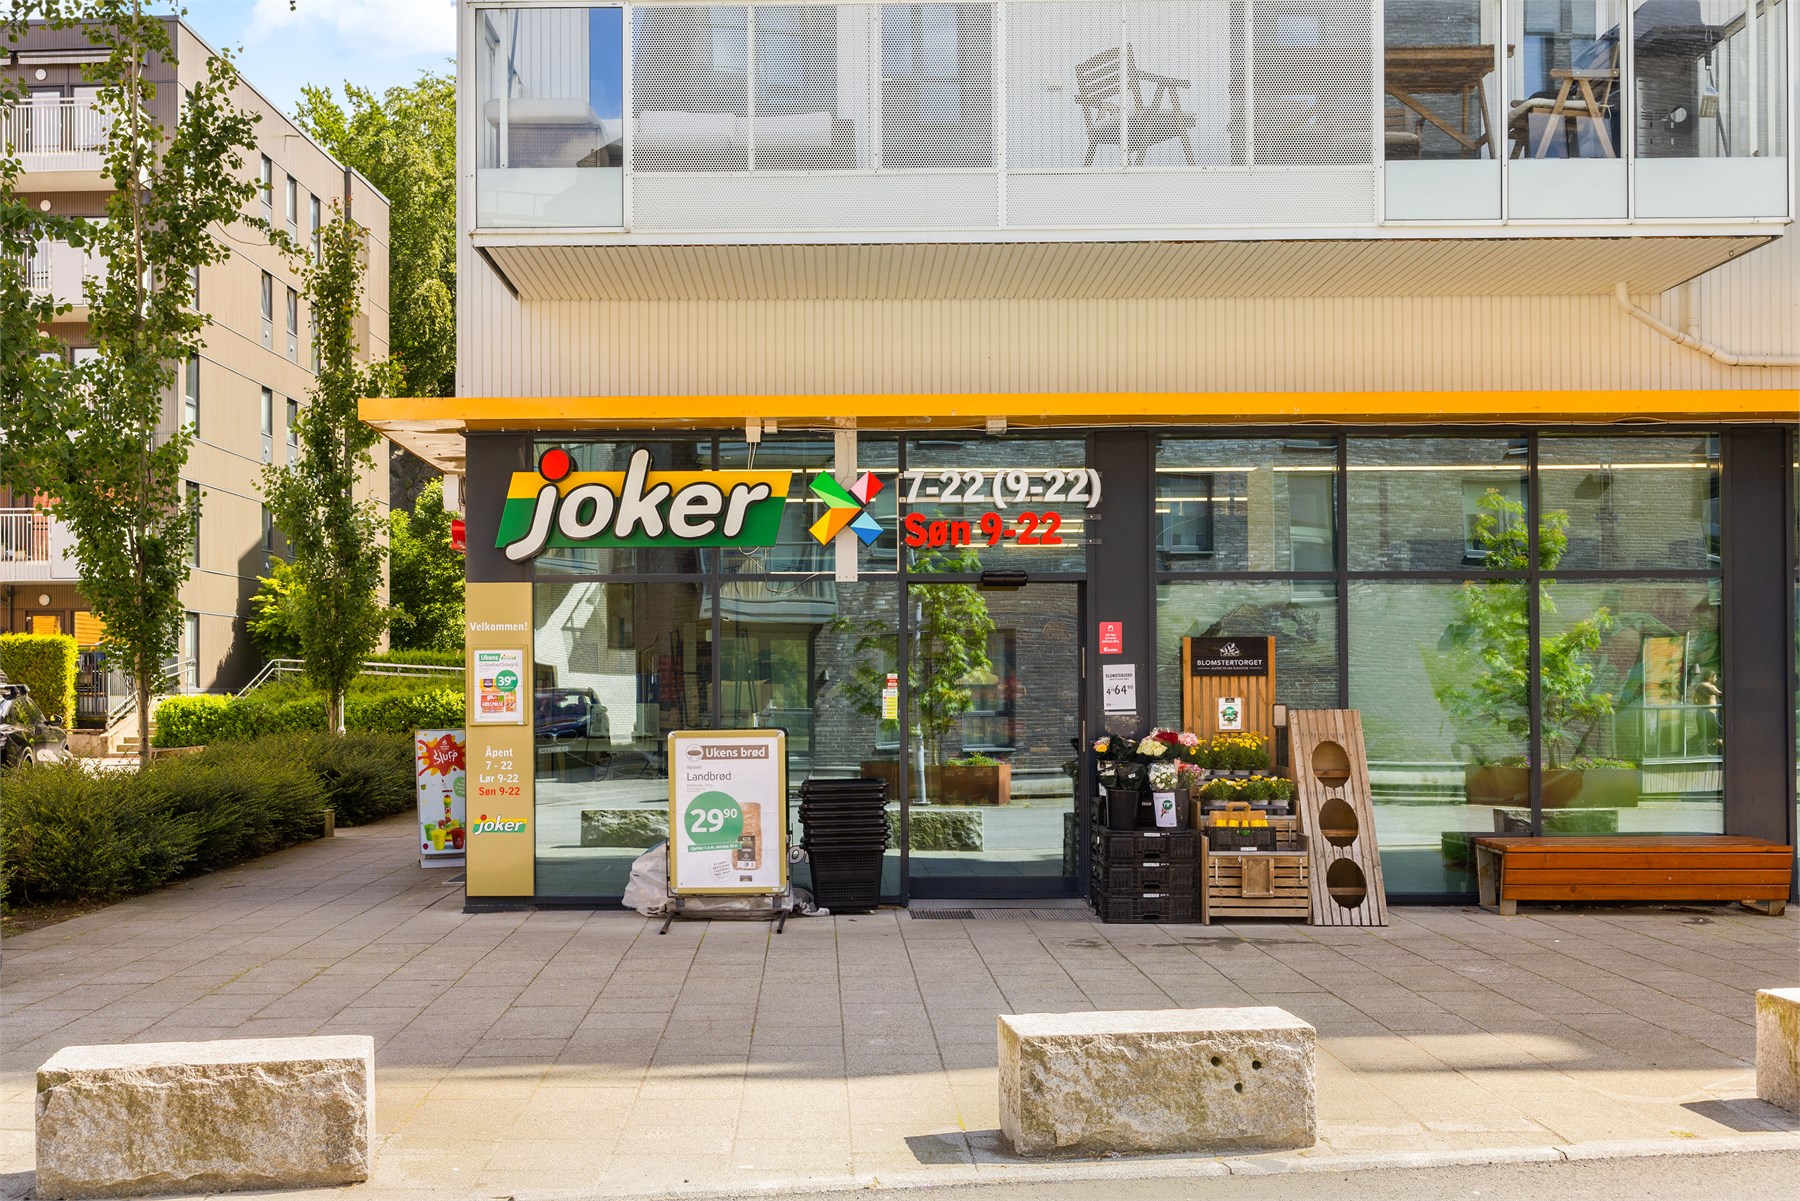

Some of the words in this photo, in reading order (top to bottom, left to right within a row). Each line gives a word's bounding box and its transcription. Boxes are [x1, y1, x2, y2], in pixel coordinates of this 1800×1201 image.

[904, 470, 985, 503] 7-22
[992, 468, 1101, 509] (9-22)
[504, 447, 771, 563] joker
[904, 512, 971, 548] Søn
[980, 511, 1063, 546] 9-22
[469, 621, 528, 631] Velkommen!
[485, 746, 514, 758] Åpent
[705, 747, 738, 757] Ukens
[740, 746, 765, 757] brød
[485, 761, 492, 770] 7
[501, 761, 513, 770] 22
[479, 774, 495, 783] Lør
[497, 774, 519, 783] 9-22
[686, 771, 732, 781] Landbrød
[478, 787, 496, 796] Søn
[499, 787, 520, 796] 9-22
[474, 814, 524, 836] joker
